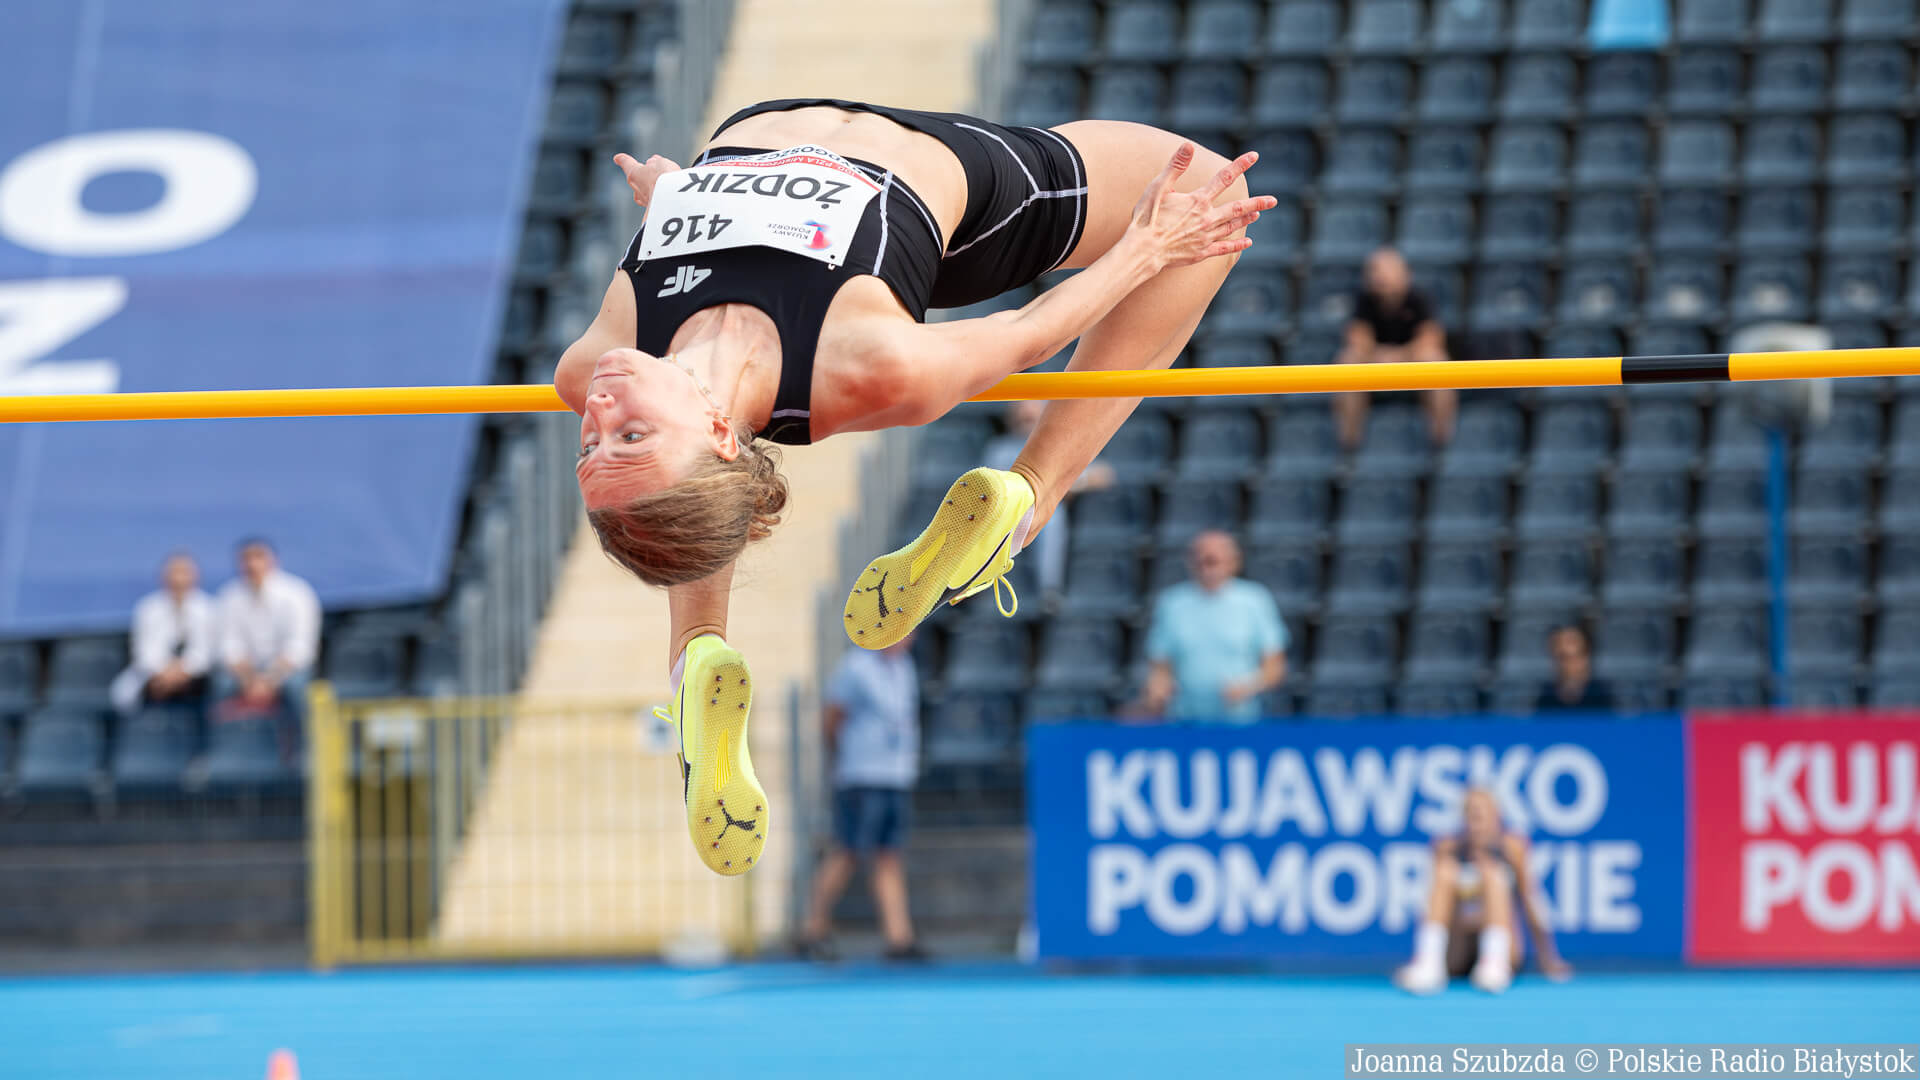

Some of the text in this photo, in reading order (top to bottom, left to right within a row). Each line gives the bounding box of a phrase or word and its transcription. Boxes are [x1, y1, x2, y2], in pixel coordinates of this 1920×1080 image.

[677, 172, 851, 210] ŻODZIK
[661, 214, 732, 247] 416
[657, 265, 712, 298] 4F
[1085, 744, 1609, 837] KUJAWSKO
[1740, 740, 1920, 835] KUJ
[1086, 840, 1643, 934] POMORIE
